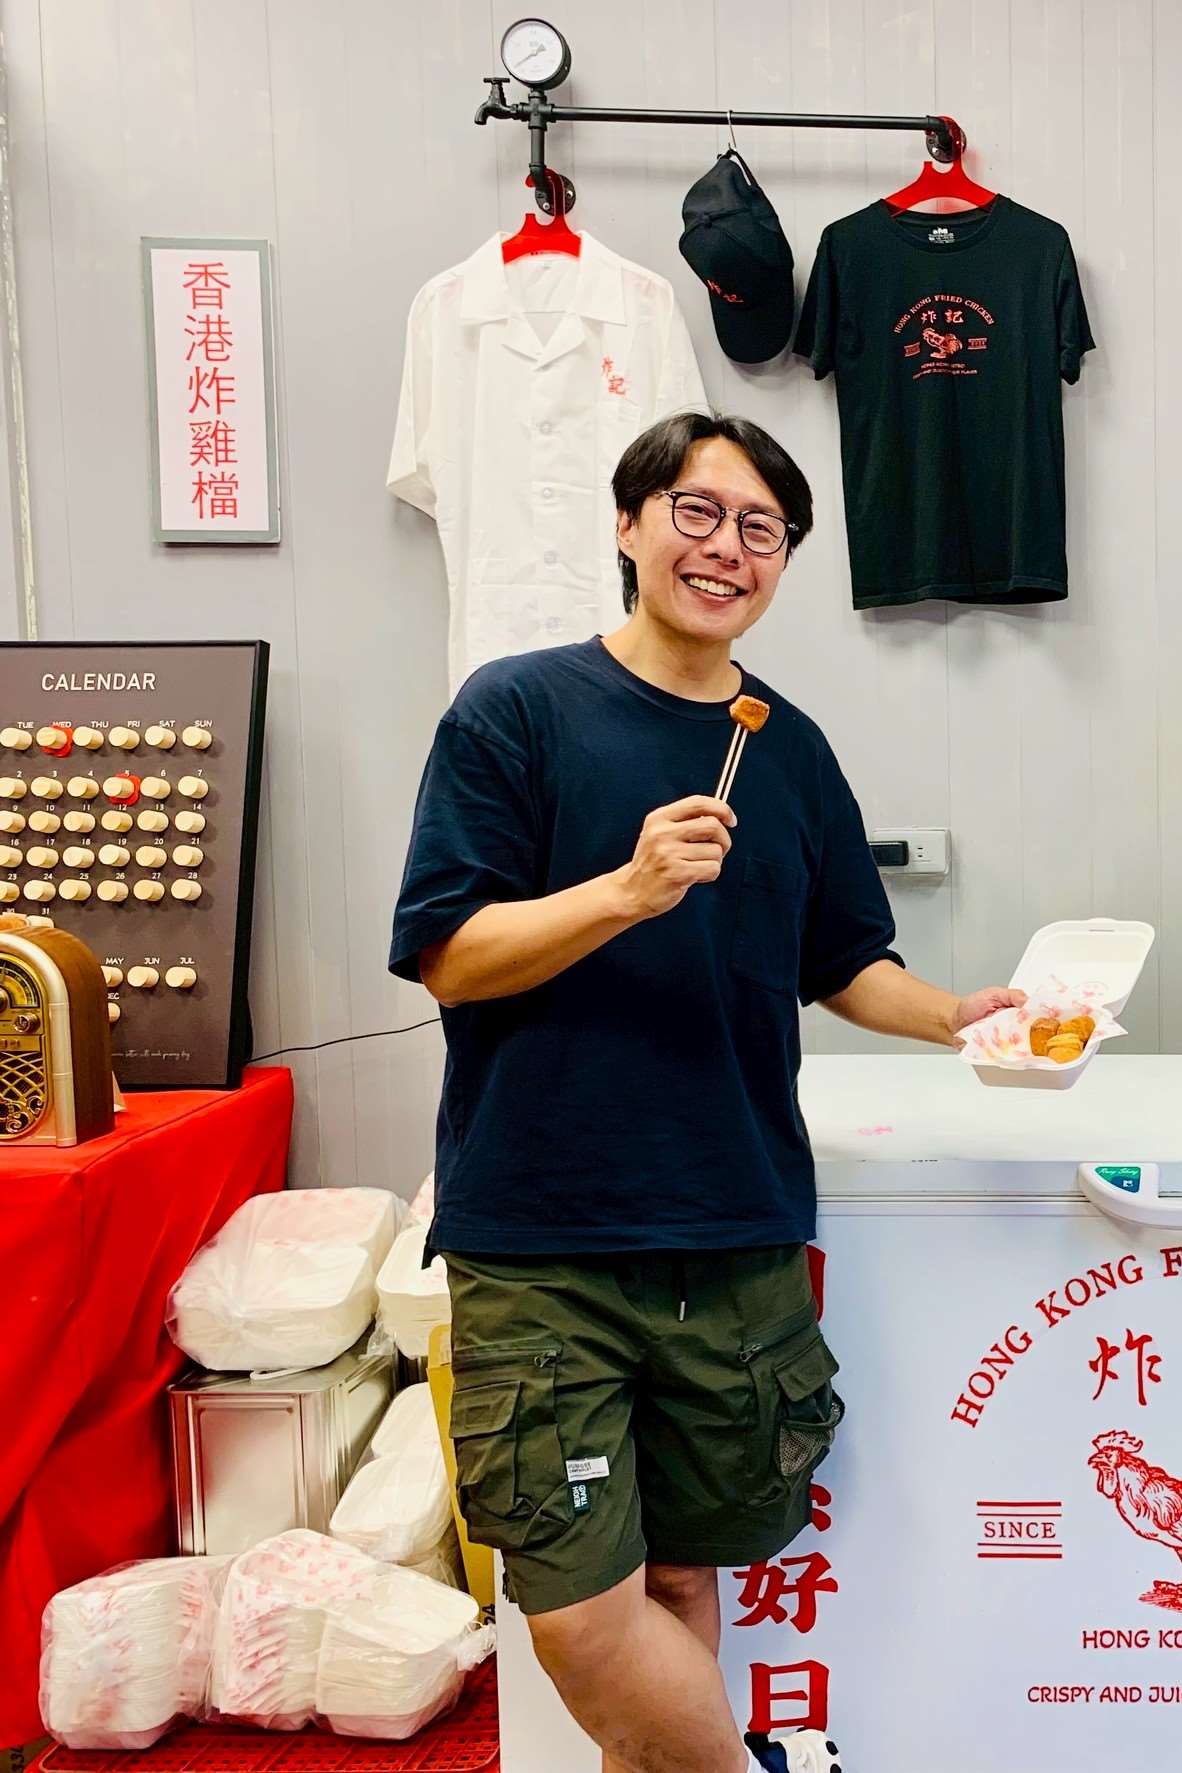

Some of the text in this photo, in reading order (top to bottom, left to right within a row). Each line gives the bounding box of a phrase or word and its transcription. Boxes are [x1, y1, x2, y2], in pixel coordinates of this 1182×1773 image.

[910, 297, 931, 314] KONG
[934, 294, 963, 304] FRIED
[965, 300, 995, 325] CHICKEN
[183, 261, 240, 520] 香港炸雞檔
[41, 673, 156, 691] CALENDAR
[17, 721, 34, 729] TUE
[91, 720, 109, 728] THU
[127, 720, 140, 728] FRI
[159, 720, 175, 728] SAT
[194, 720, 213, 728] SUN
[950, 1325, 1033, 1429] HONG
[1035, 1255, 1144, 1328] KONG
[983, 1521, 1057, 1539] SINCE
[1082, 1629, 1150, 1649] HONG
[1027, 1686, 1094, 1704] CRISPY
[1100, 1686, 1142, 1703] AND
